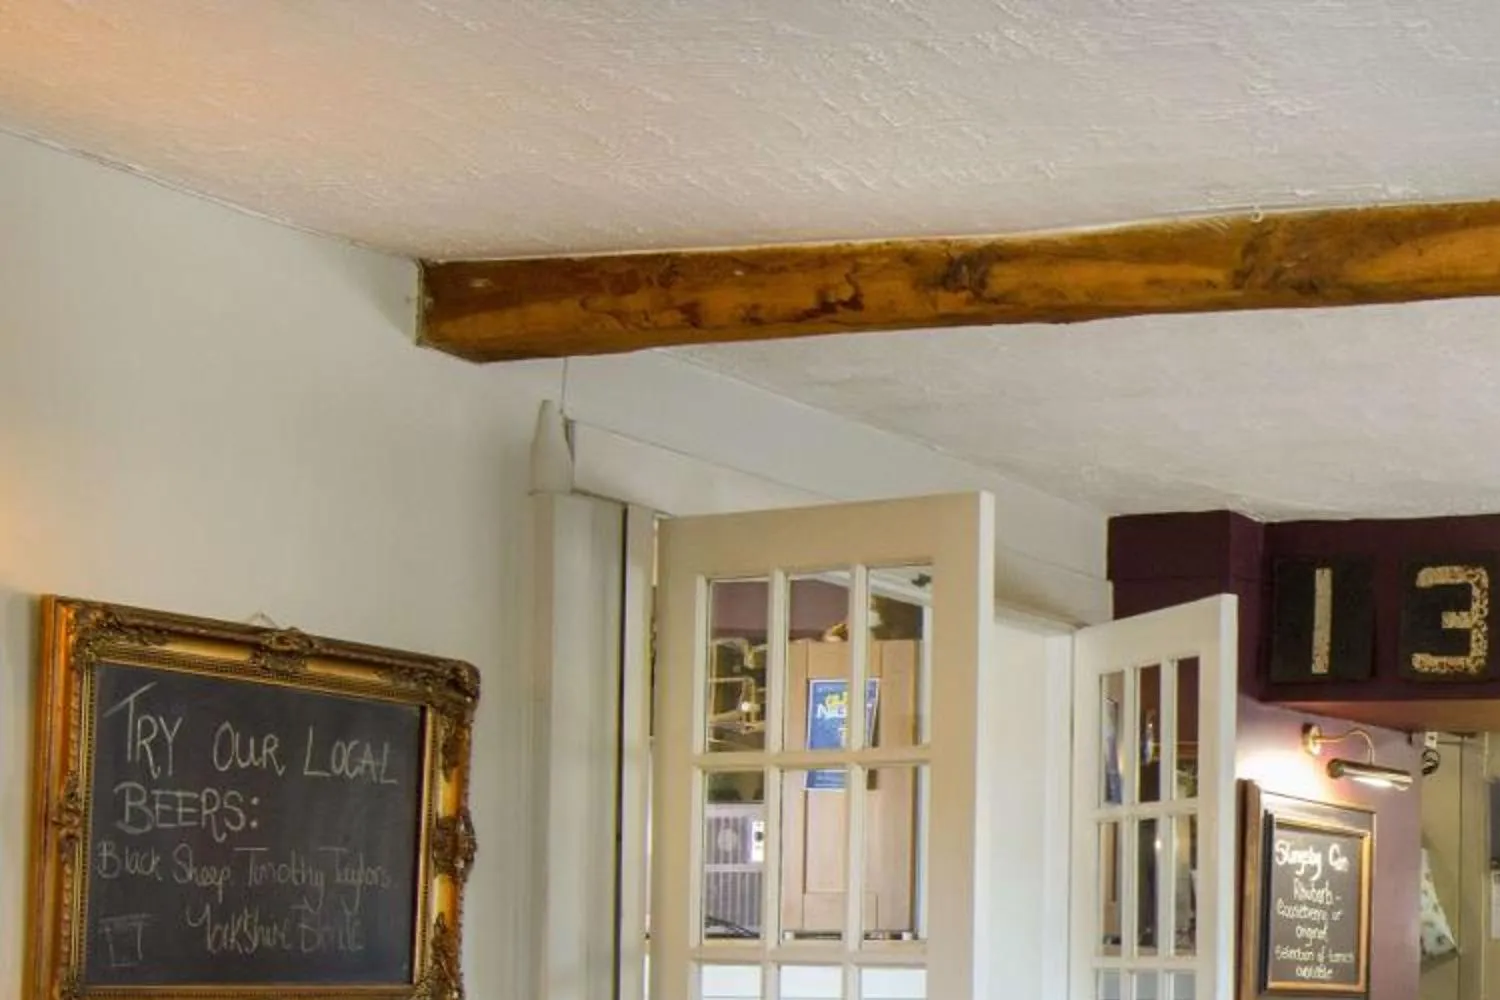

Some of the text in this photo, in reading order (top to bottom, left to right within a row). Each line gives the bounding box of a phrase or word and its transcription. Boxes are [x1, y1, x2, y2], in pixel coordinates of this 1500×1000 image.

[1311, 567, 1332, 674] 1
[1411, 564, 1490, 674] 3
[103, 681, 398, 784] TRY OUR LOCAL
[113, 781, 259, 843] BEERS:
[97, 841, 163, 882] Black
